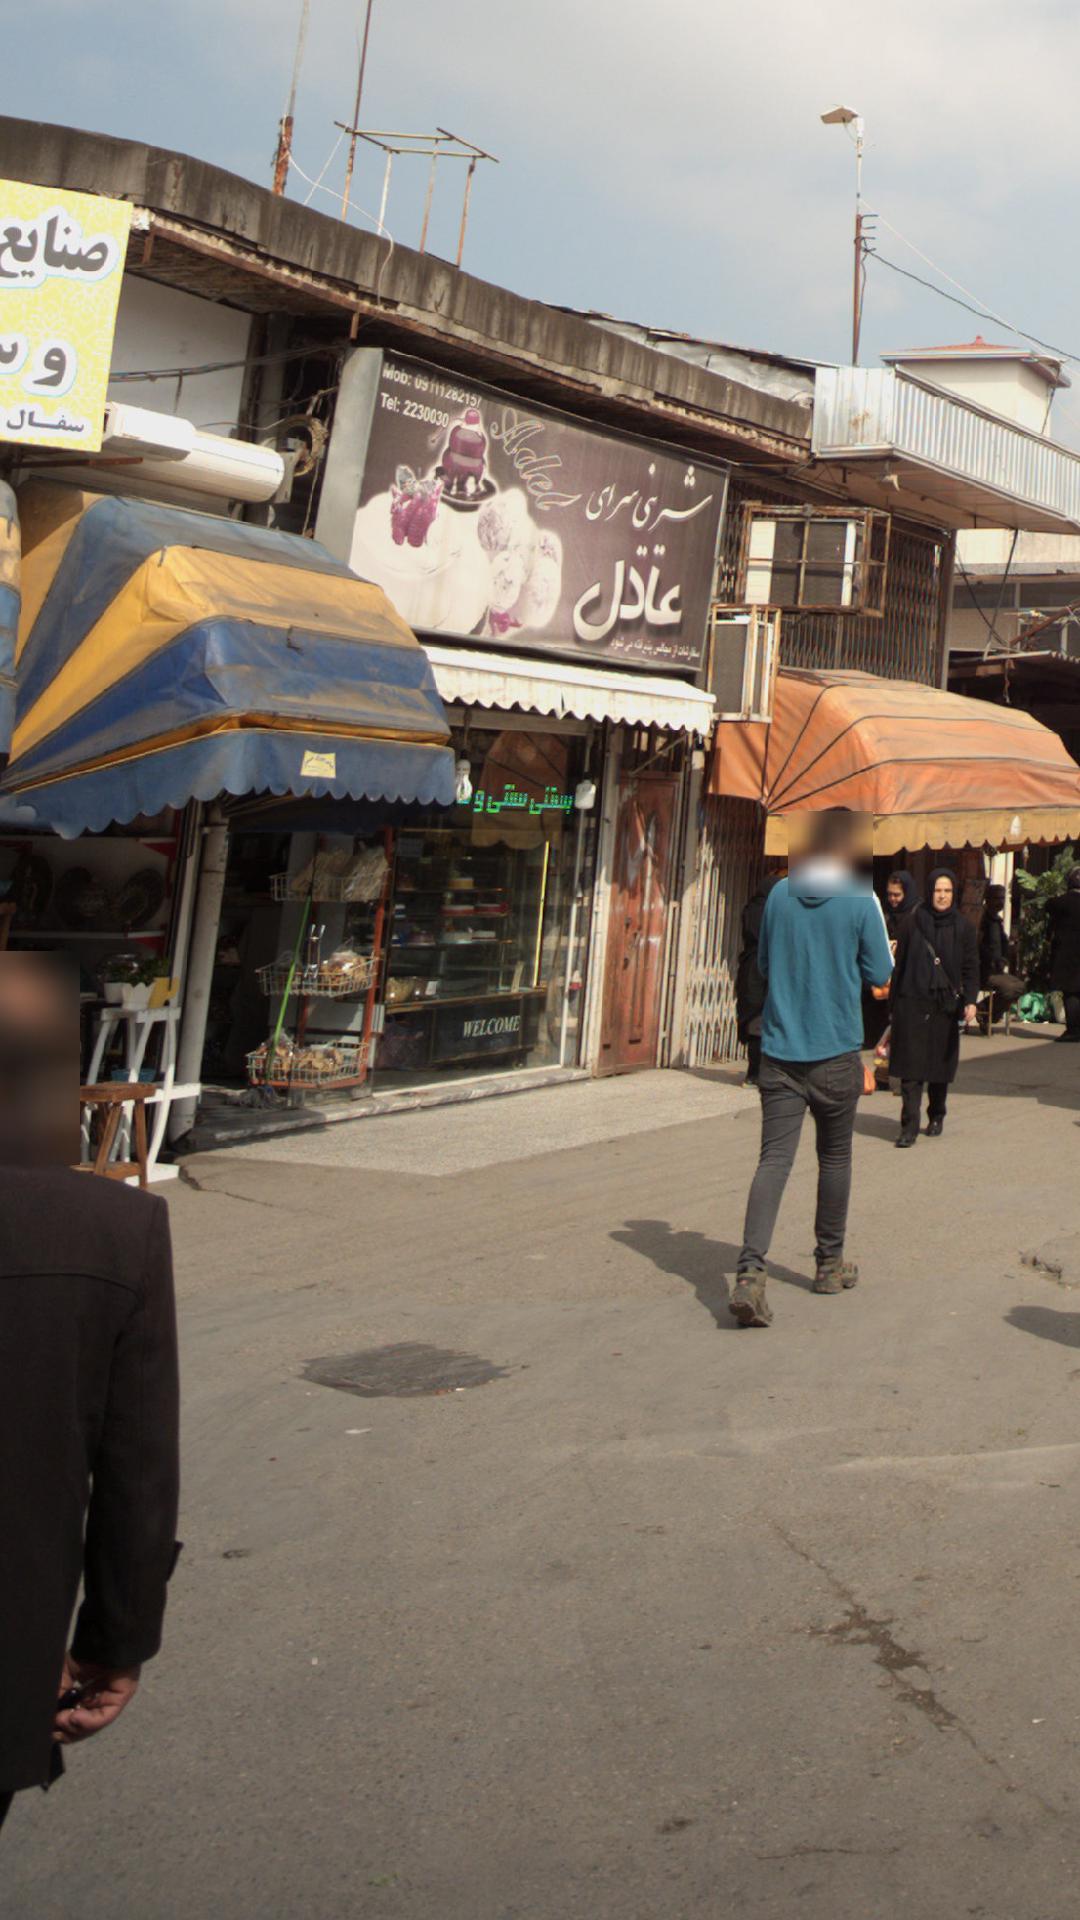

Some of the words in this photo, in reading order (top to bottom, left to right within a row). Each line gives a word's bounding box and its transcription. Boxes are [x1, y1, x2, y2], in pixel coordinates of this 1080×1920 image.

[0, 215, 109, 278] صنایع
[381, 392, 401, 413] Tel:
[403, 400, 449, 428] 2230030
[573, 559, 683, 641] عادل
[463, 1015, 520, 1037] WELCOME
